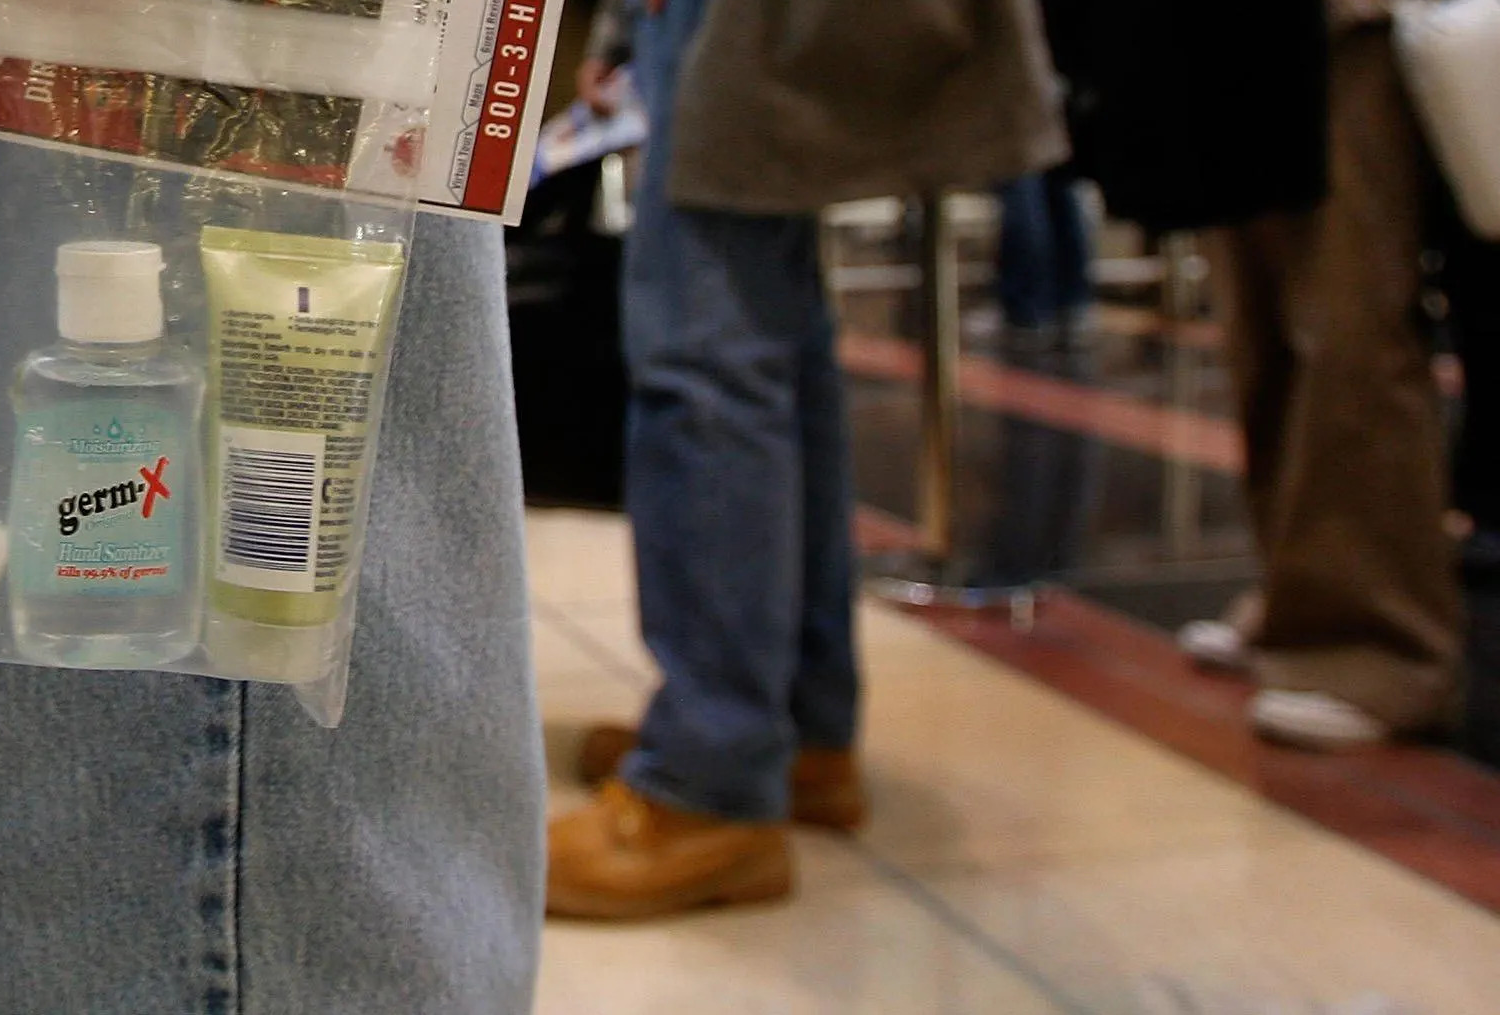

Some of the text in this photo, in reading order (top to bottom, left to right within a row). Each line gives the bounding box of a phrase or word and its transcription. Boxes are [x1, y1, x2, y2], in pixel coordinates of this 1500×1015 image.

[481, 25, 496, 54] Guest
[469, 83, 484, 108] Maps
[453, 131, 473, 191] Virtual Tours
[119, 565, 131, 578] of
